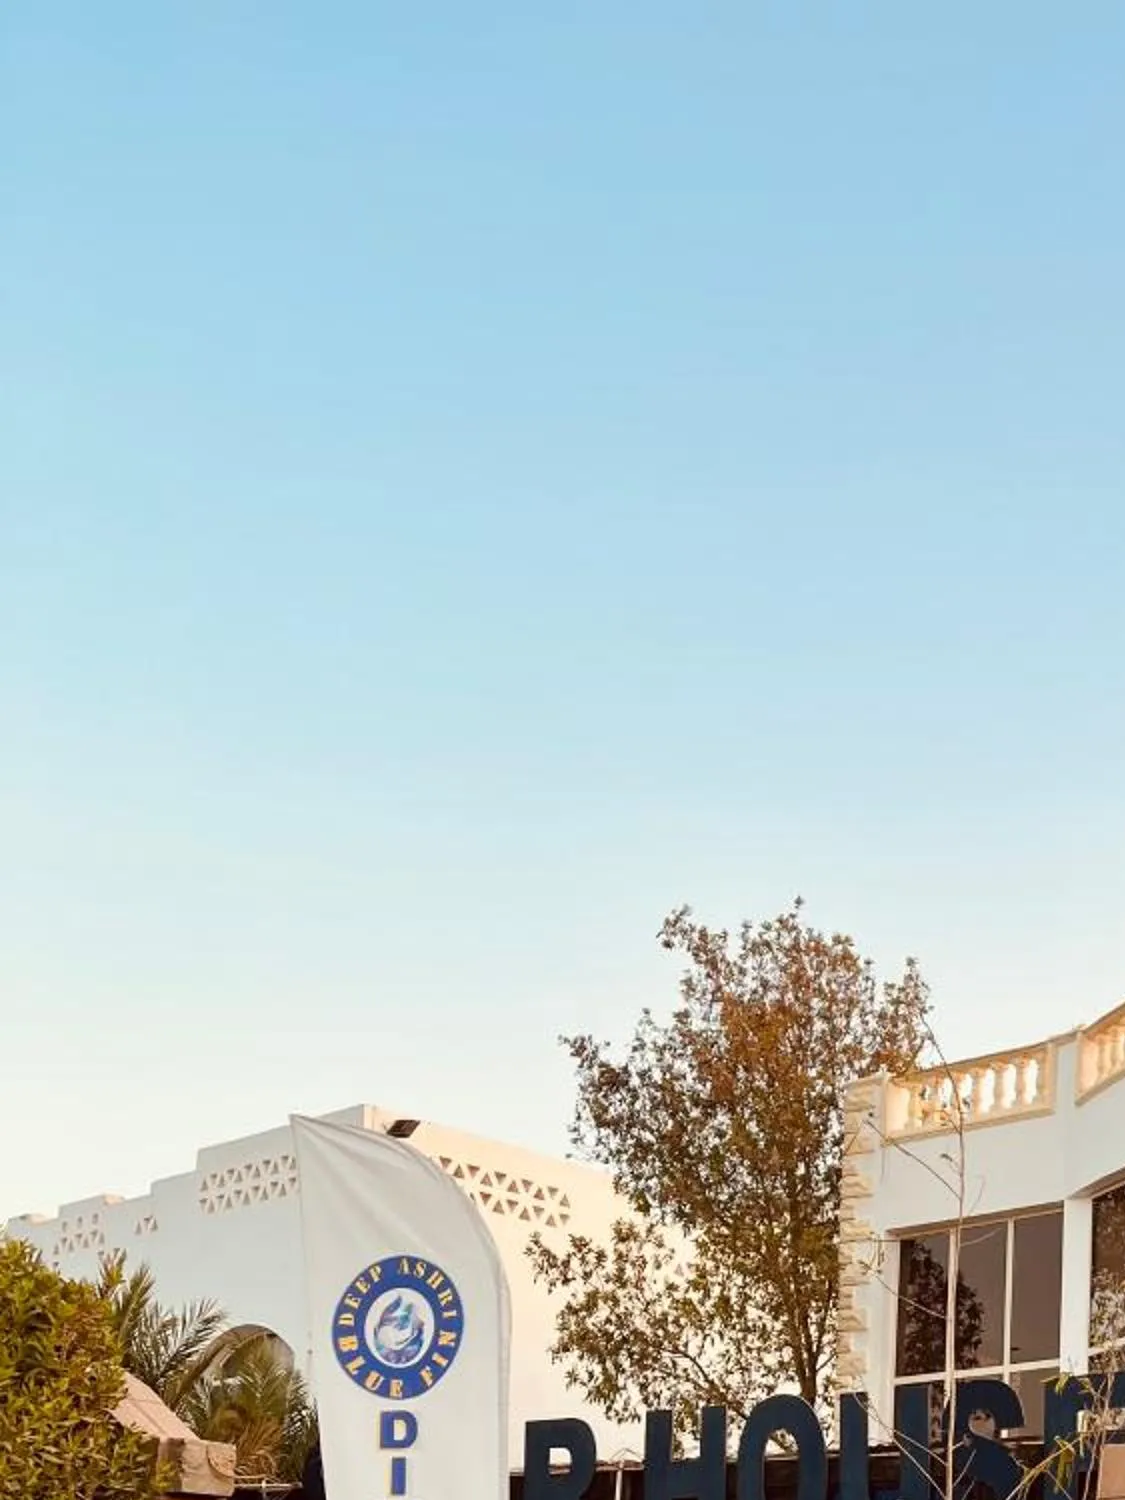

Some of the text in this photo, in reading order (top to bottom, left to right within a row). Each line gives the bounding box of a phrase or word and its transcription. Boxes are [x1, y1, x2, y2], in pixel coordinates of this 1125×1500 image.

[338, 1258, 457, 1326] DEEP ASHRI
[338, 1330, 457, 1397] BLUE FIN
